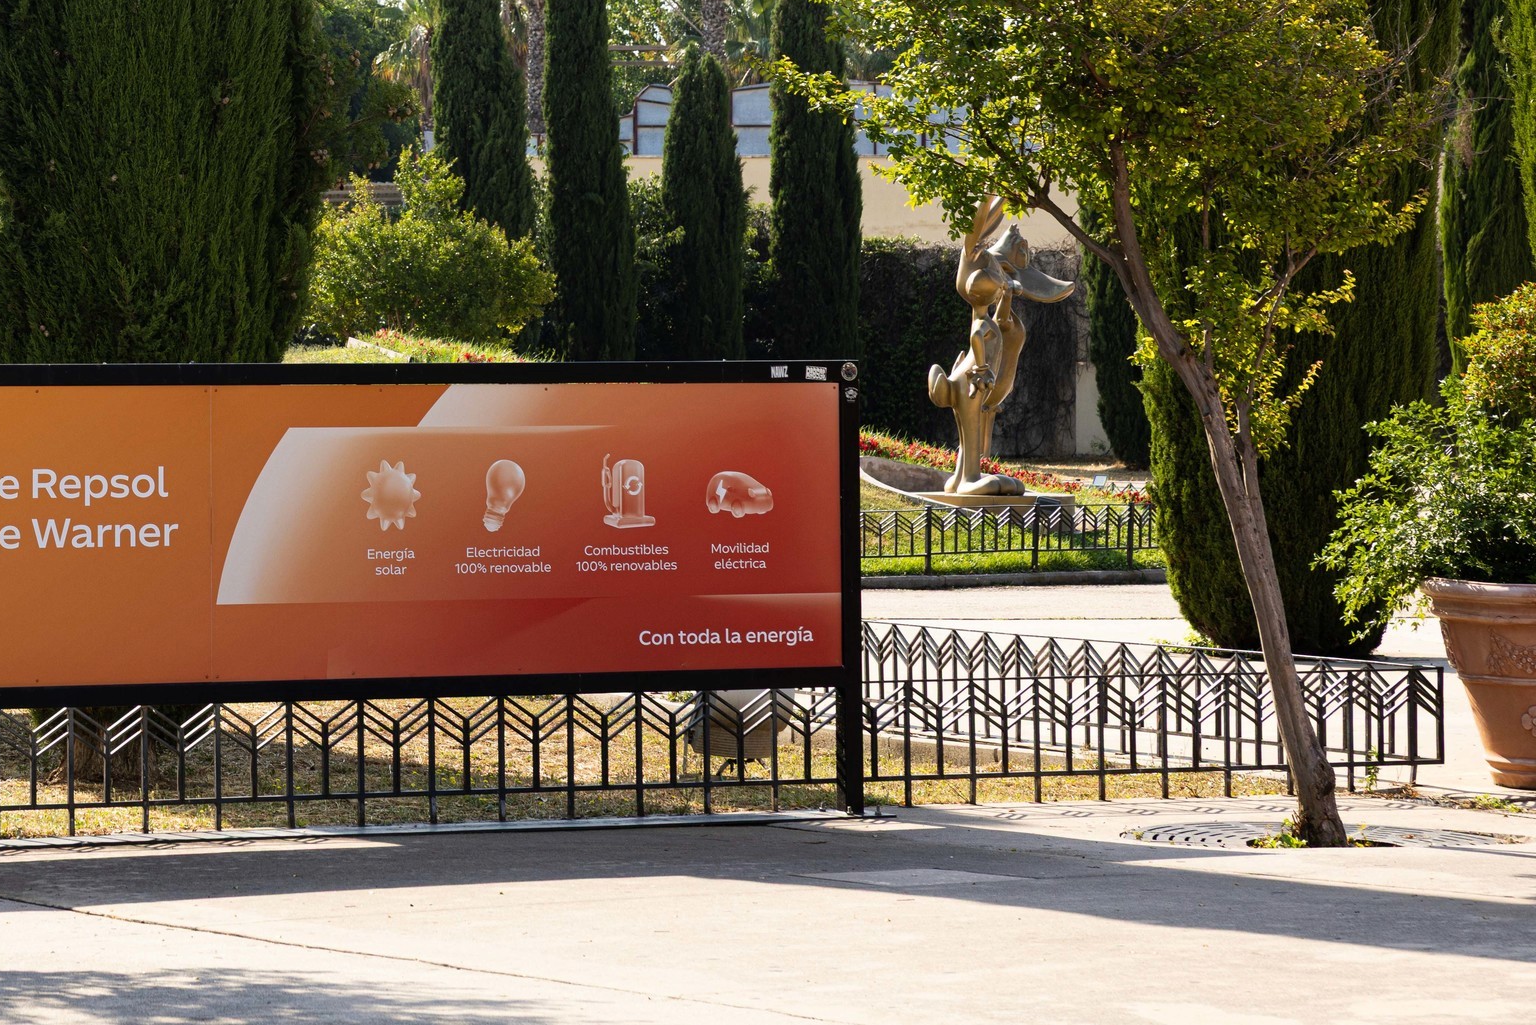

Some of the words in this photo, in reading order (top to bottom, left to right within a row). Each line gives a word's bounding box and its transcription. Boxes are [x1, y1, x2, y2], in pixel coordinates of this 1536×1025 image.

[33, 466, 168, 506] Repsol
[32, 518, 178, 548] Warner
[467, 546, 539, 557] Electricidad
[585, 545, 668, 555] Combustibles
[712, 543, 769, 553] Movilidad
[368, 549, 415, 561] Energía
[376, 564, 406, 575] solar
[455, 563, 486, 573] 100%
[490, 562, 551, 573] renovable
[576, 561, 607, 571] 100%
[611, 560, 677, 571] renovables
[715, 559, 766, 569] eléctrica
[639, 631, 673, 645] Con
[678, 629, 721, 644] toda
[726, 628, 742, 643] la
[746, 627, 813, 646] energía
